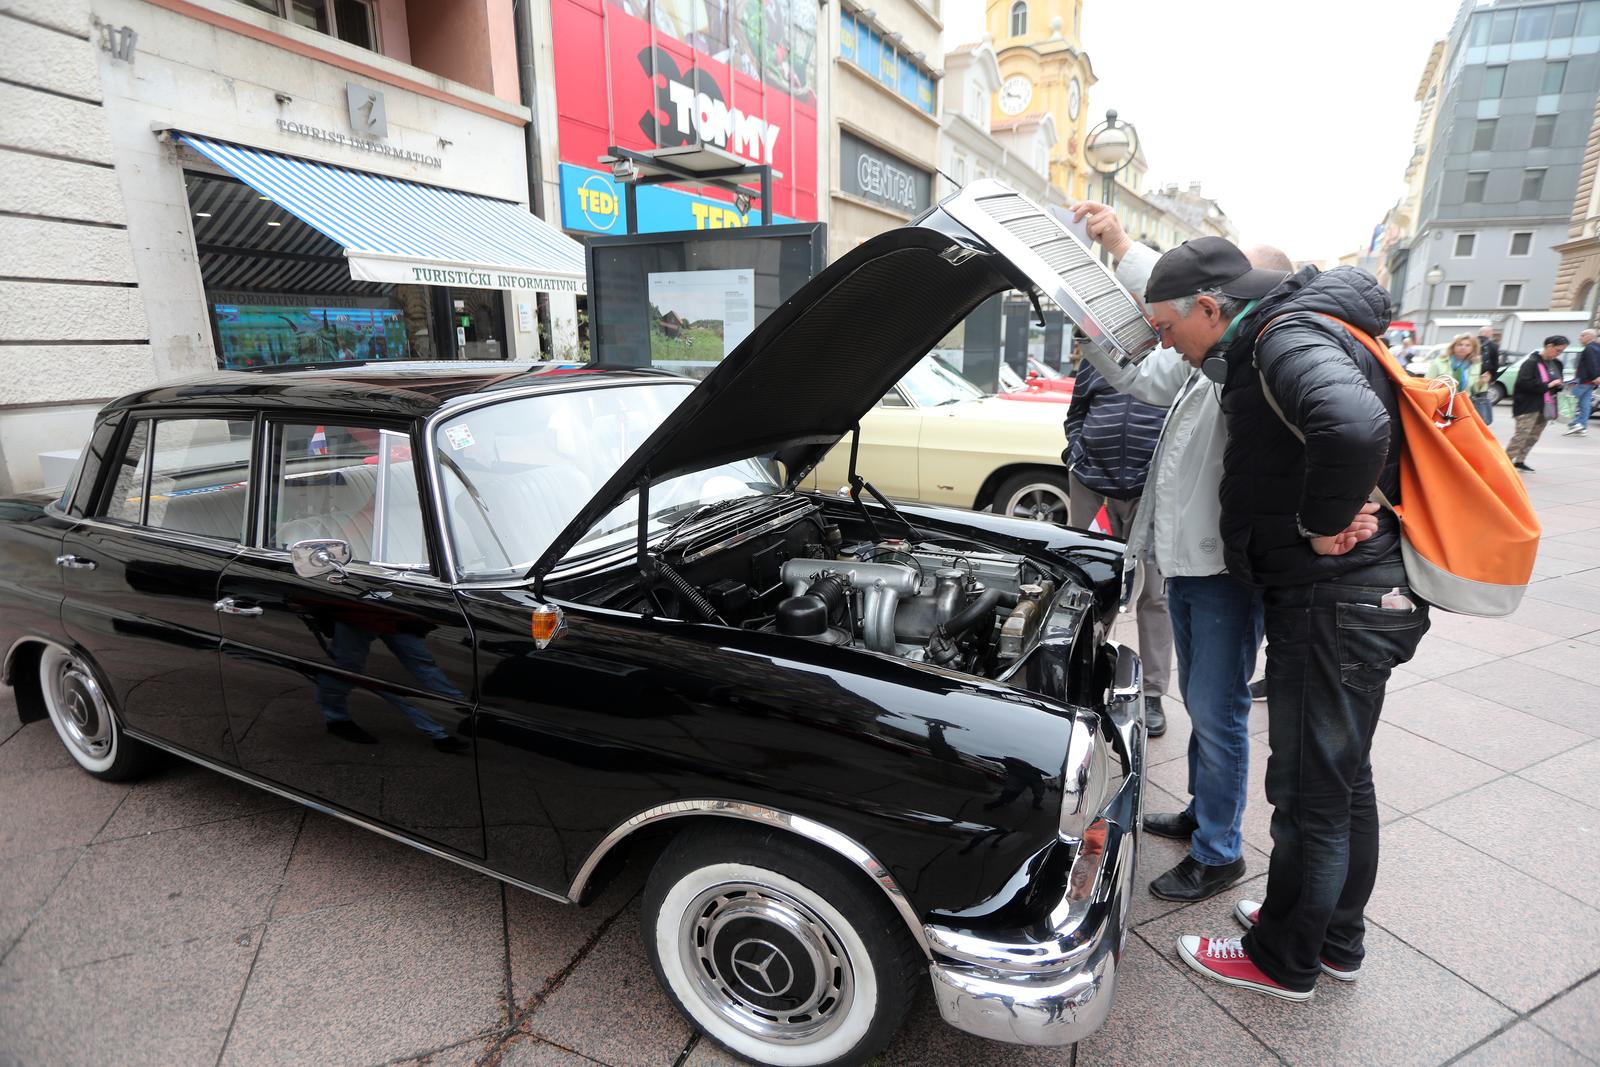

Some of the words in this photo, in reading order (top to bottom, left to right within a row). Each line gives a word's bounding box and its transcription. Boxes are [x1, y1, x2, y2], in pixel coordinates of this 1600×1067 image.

[276, 118, 346, 145] TOURIST
[350, 138, 442, 169] INFORMATION
[669, 79, 780, 164] TOMMY
[577, 187, 619, 218] TEDi
[857, 153, 916, 210] CENTRA
[412, 267, 492, 286] TURISTIČKI
[498, 275, 577, 292] INFORMATIVNI
